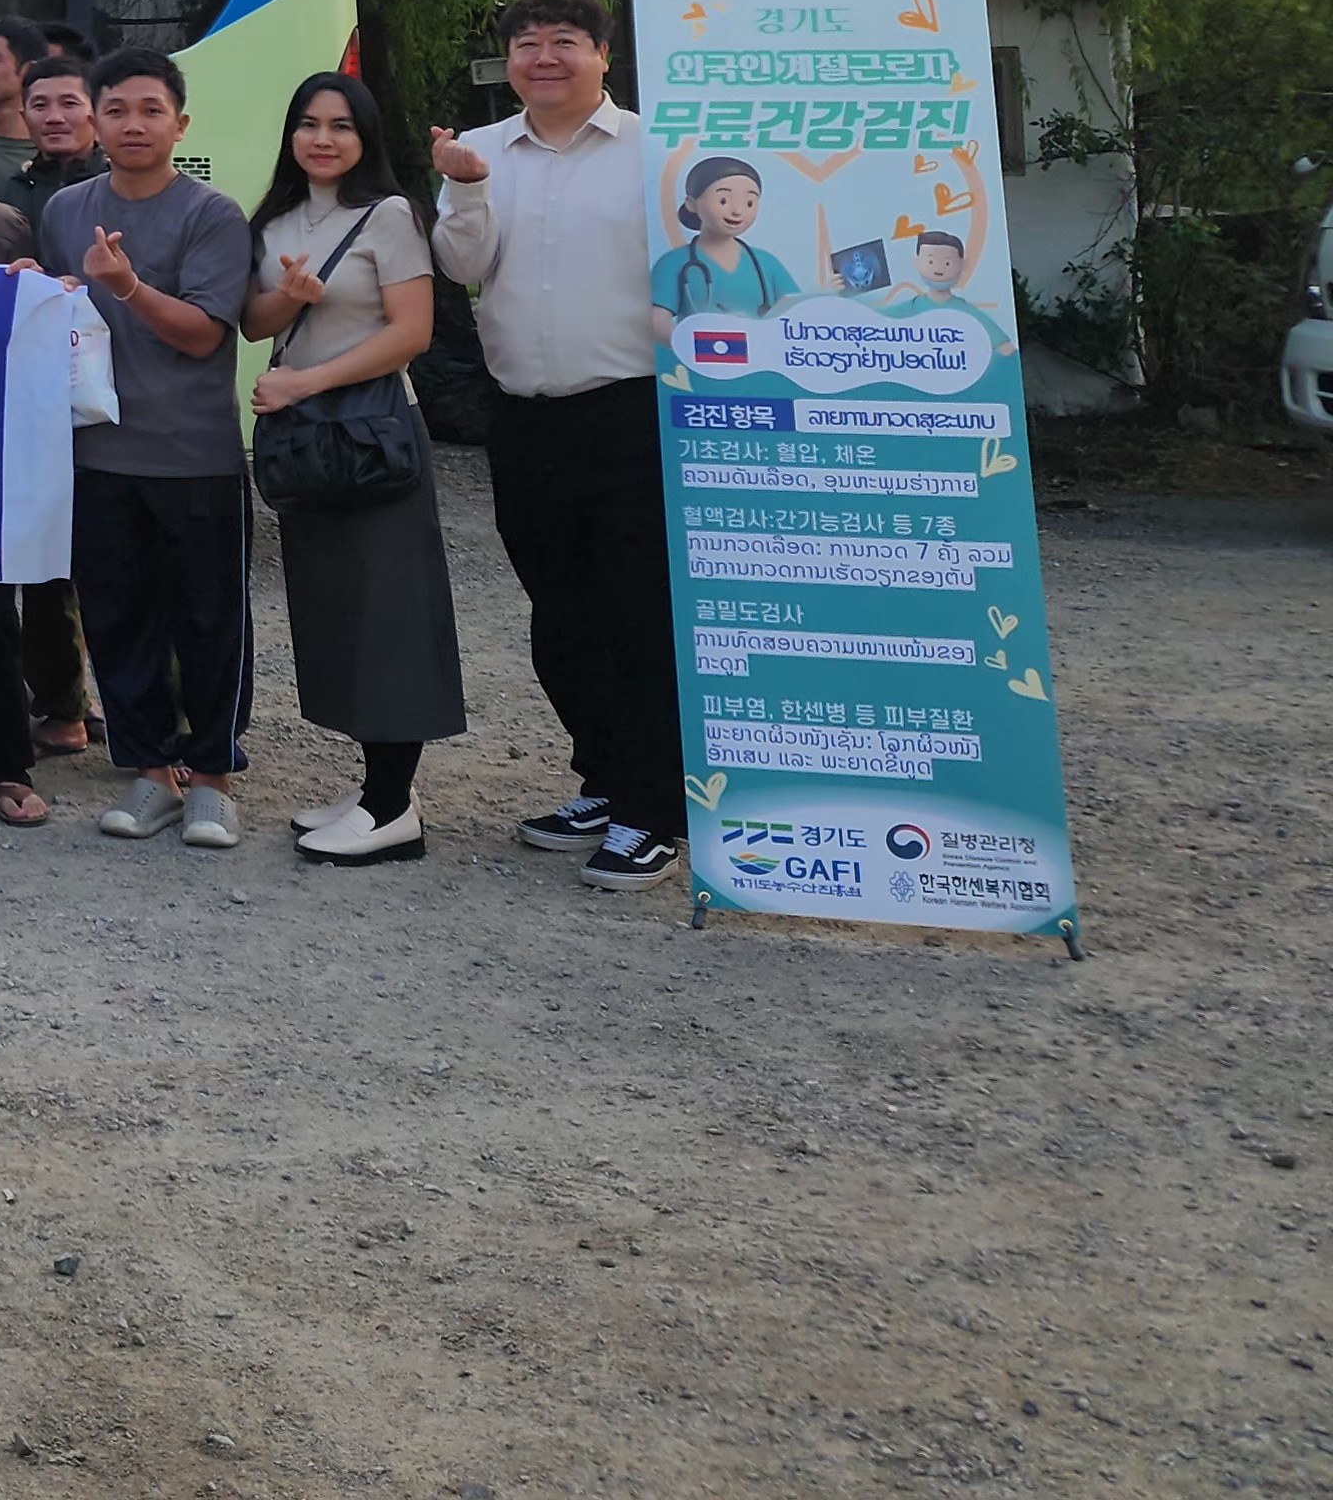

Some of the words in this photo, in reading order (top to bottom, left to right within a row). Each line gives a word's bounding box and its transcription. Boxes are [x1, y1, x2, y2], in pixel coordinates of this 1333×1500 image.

[755, 6, 854, 34] 경기도
[668, 51, 775, 84] 외국인
[650, 100, 972, 150] 무료건강검진
[683, 404, 728, 428] 검진
[730, 404, 777, 430] 항목
[678, 439, 769, 461] 기초검사:
[777, 443, 826, 464] 혈압,
[835, 444, 876, 465] 체온
[892, 514, 913, 535] 등
[920, 515, 957, 536] 7종
[916, 542, 928, 560] 7
[696, 599, 804, 624] 골밀도검사
[703, 695, 774, 720] 피부염,
[781, 699, 847, 724] 한센병
[855, 704, 875, 726] 등
[884, 706, 974, 731] 피부질환
[801, 825, 867, 848] 경기도
[940, 832, 1035, 855] 질병관리청
[785, 856, 862, 883] GAFI
[918, 873, 1051, 903] 한국한센복지협회
